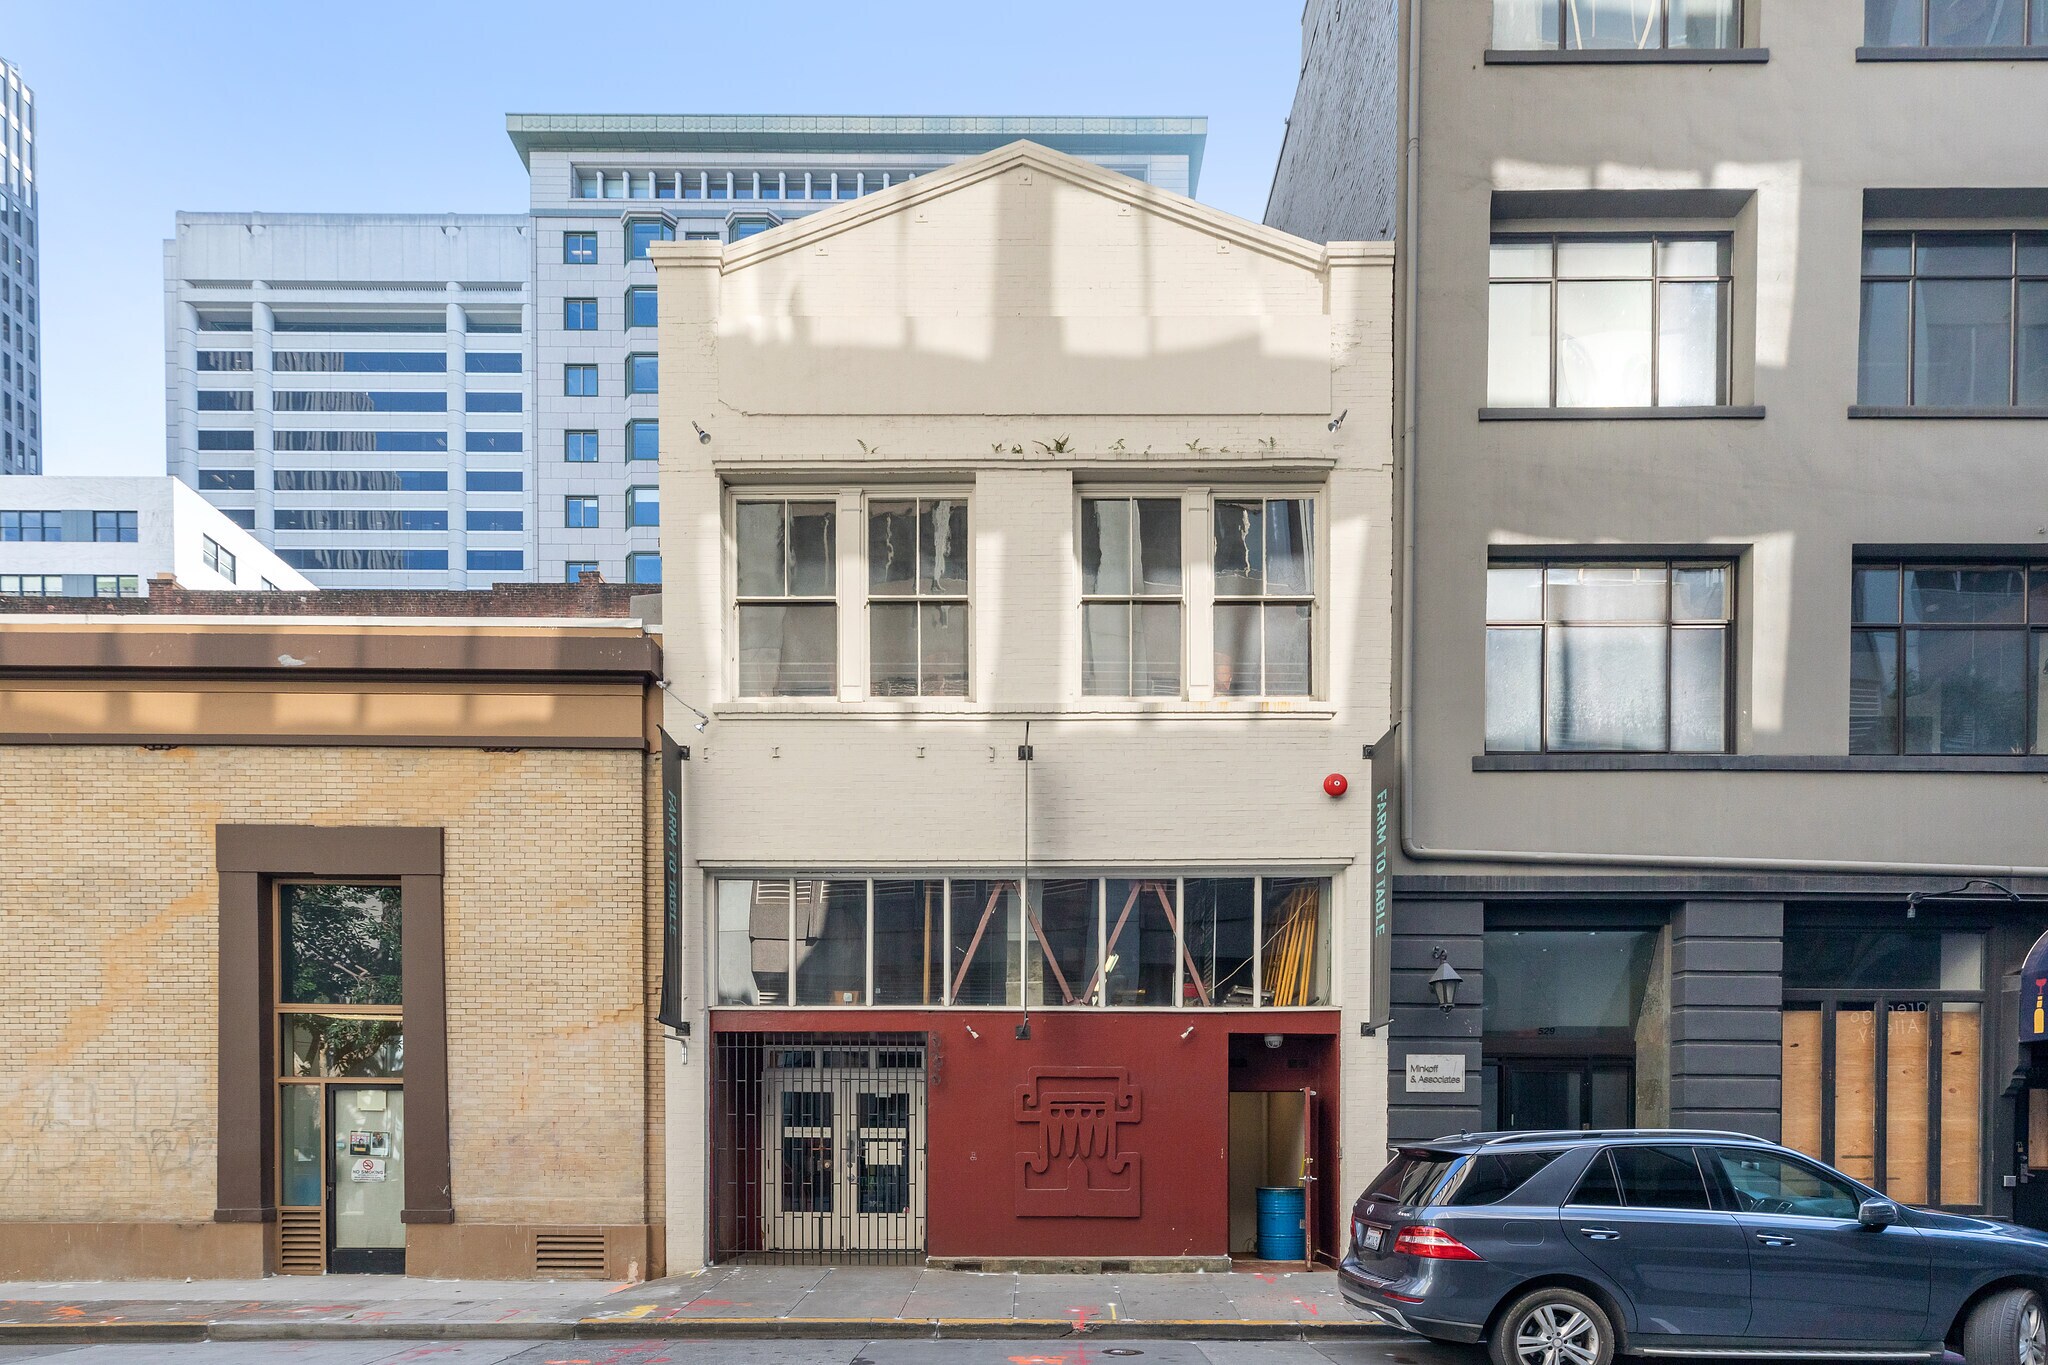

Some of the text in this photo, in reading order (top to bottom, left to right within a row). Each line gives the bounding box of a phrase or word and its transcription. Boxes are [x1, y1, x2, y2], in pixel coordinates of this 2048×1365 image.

[668, 790, 677, 936] FARM TO TABLE
[1375, 788, 1387, 938] FARM TO TABLE
[1538, 1027, 1555, 1035] 529
[1410, 1064, 1439, 1073] Minkoff
[1410, 1075, 1461, 1084] & Associates
